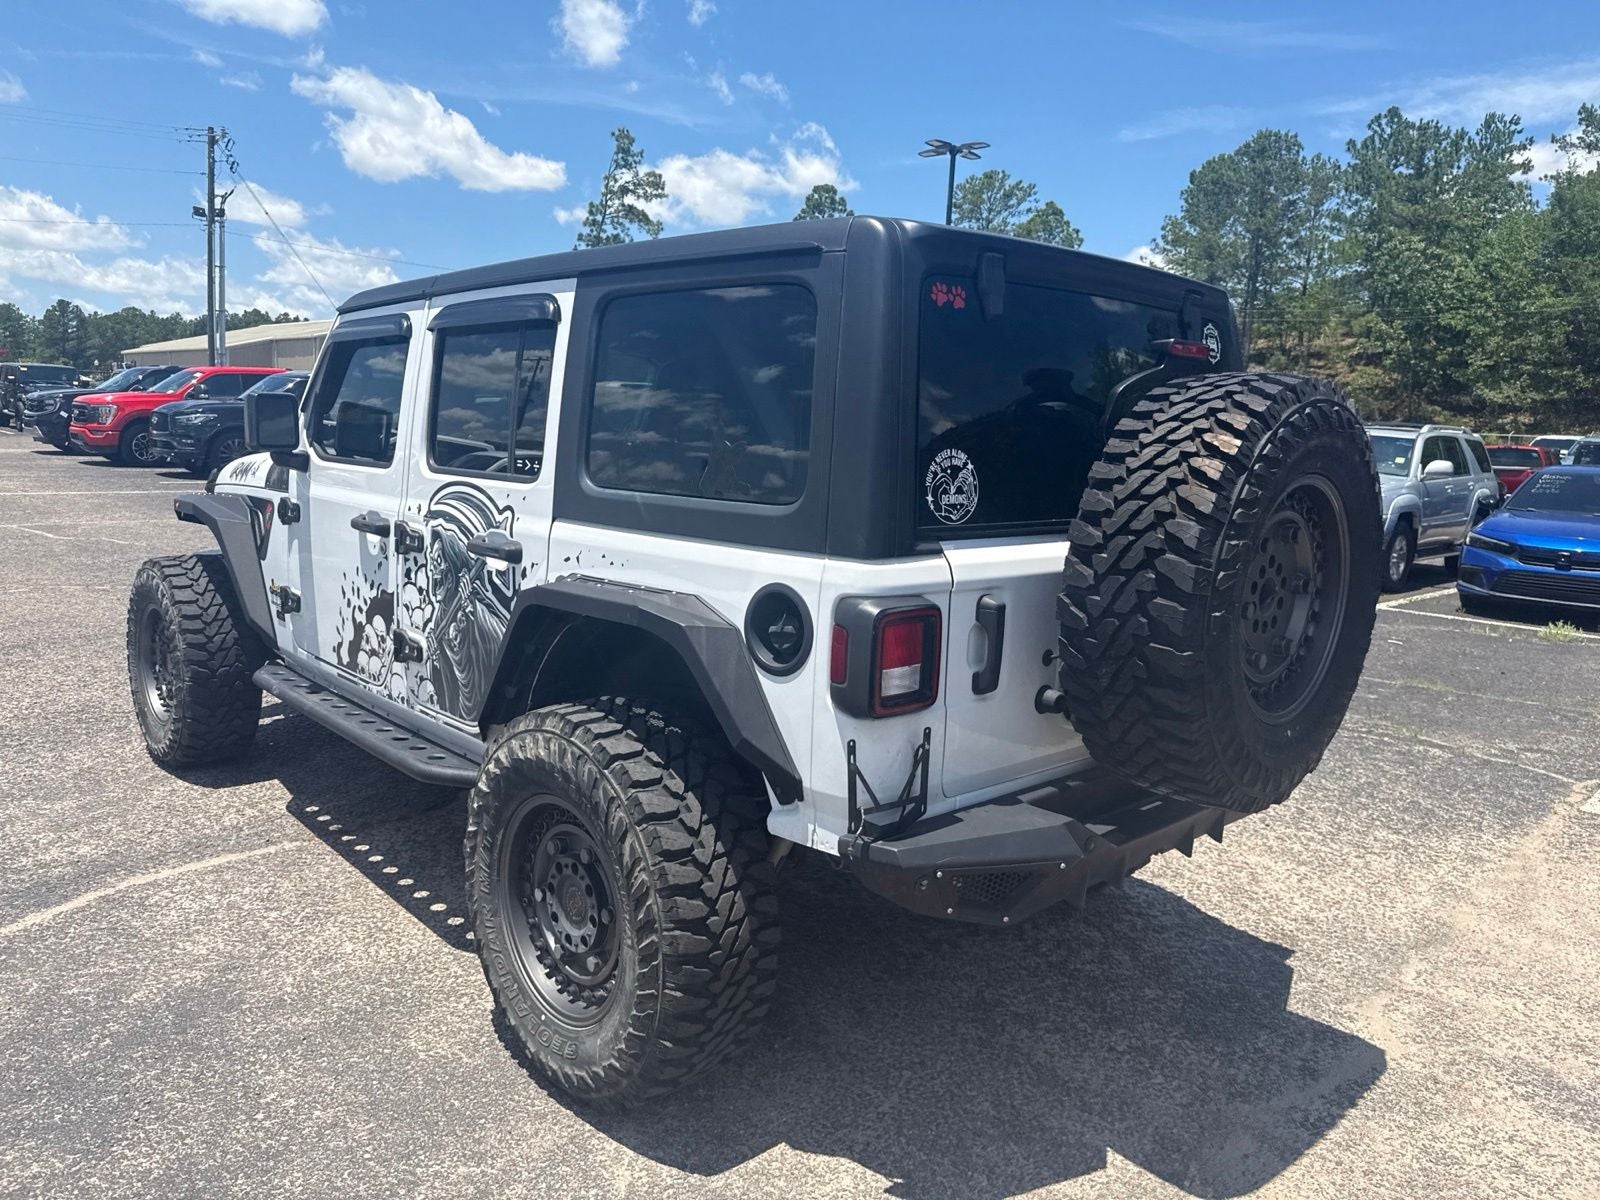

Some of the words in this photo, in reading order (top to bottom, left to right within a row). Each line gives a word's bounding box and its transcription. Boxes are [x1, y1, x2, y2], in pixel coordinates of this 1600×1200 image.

[925, 461, 938, 486] YOU'RE
[935, 448, 951, 464] NEVER
[952, 448, 968, 460] ALONE
[940, 458, 951, 469] YOU
[952, 457, 965, 468] HAVE
[941, 494, 967, 504] DEMONS
[482, 903, 579, 1060] GEOLANDAR
